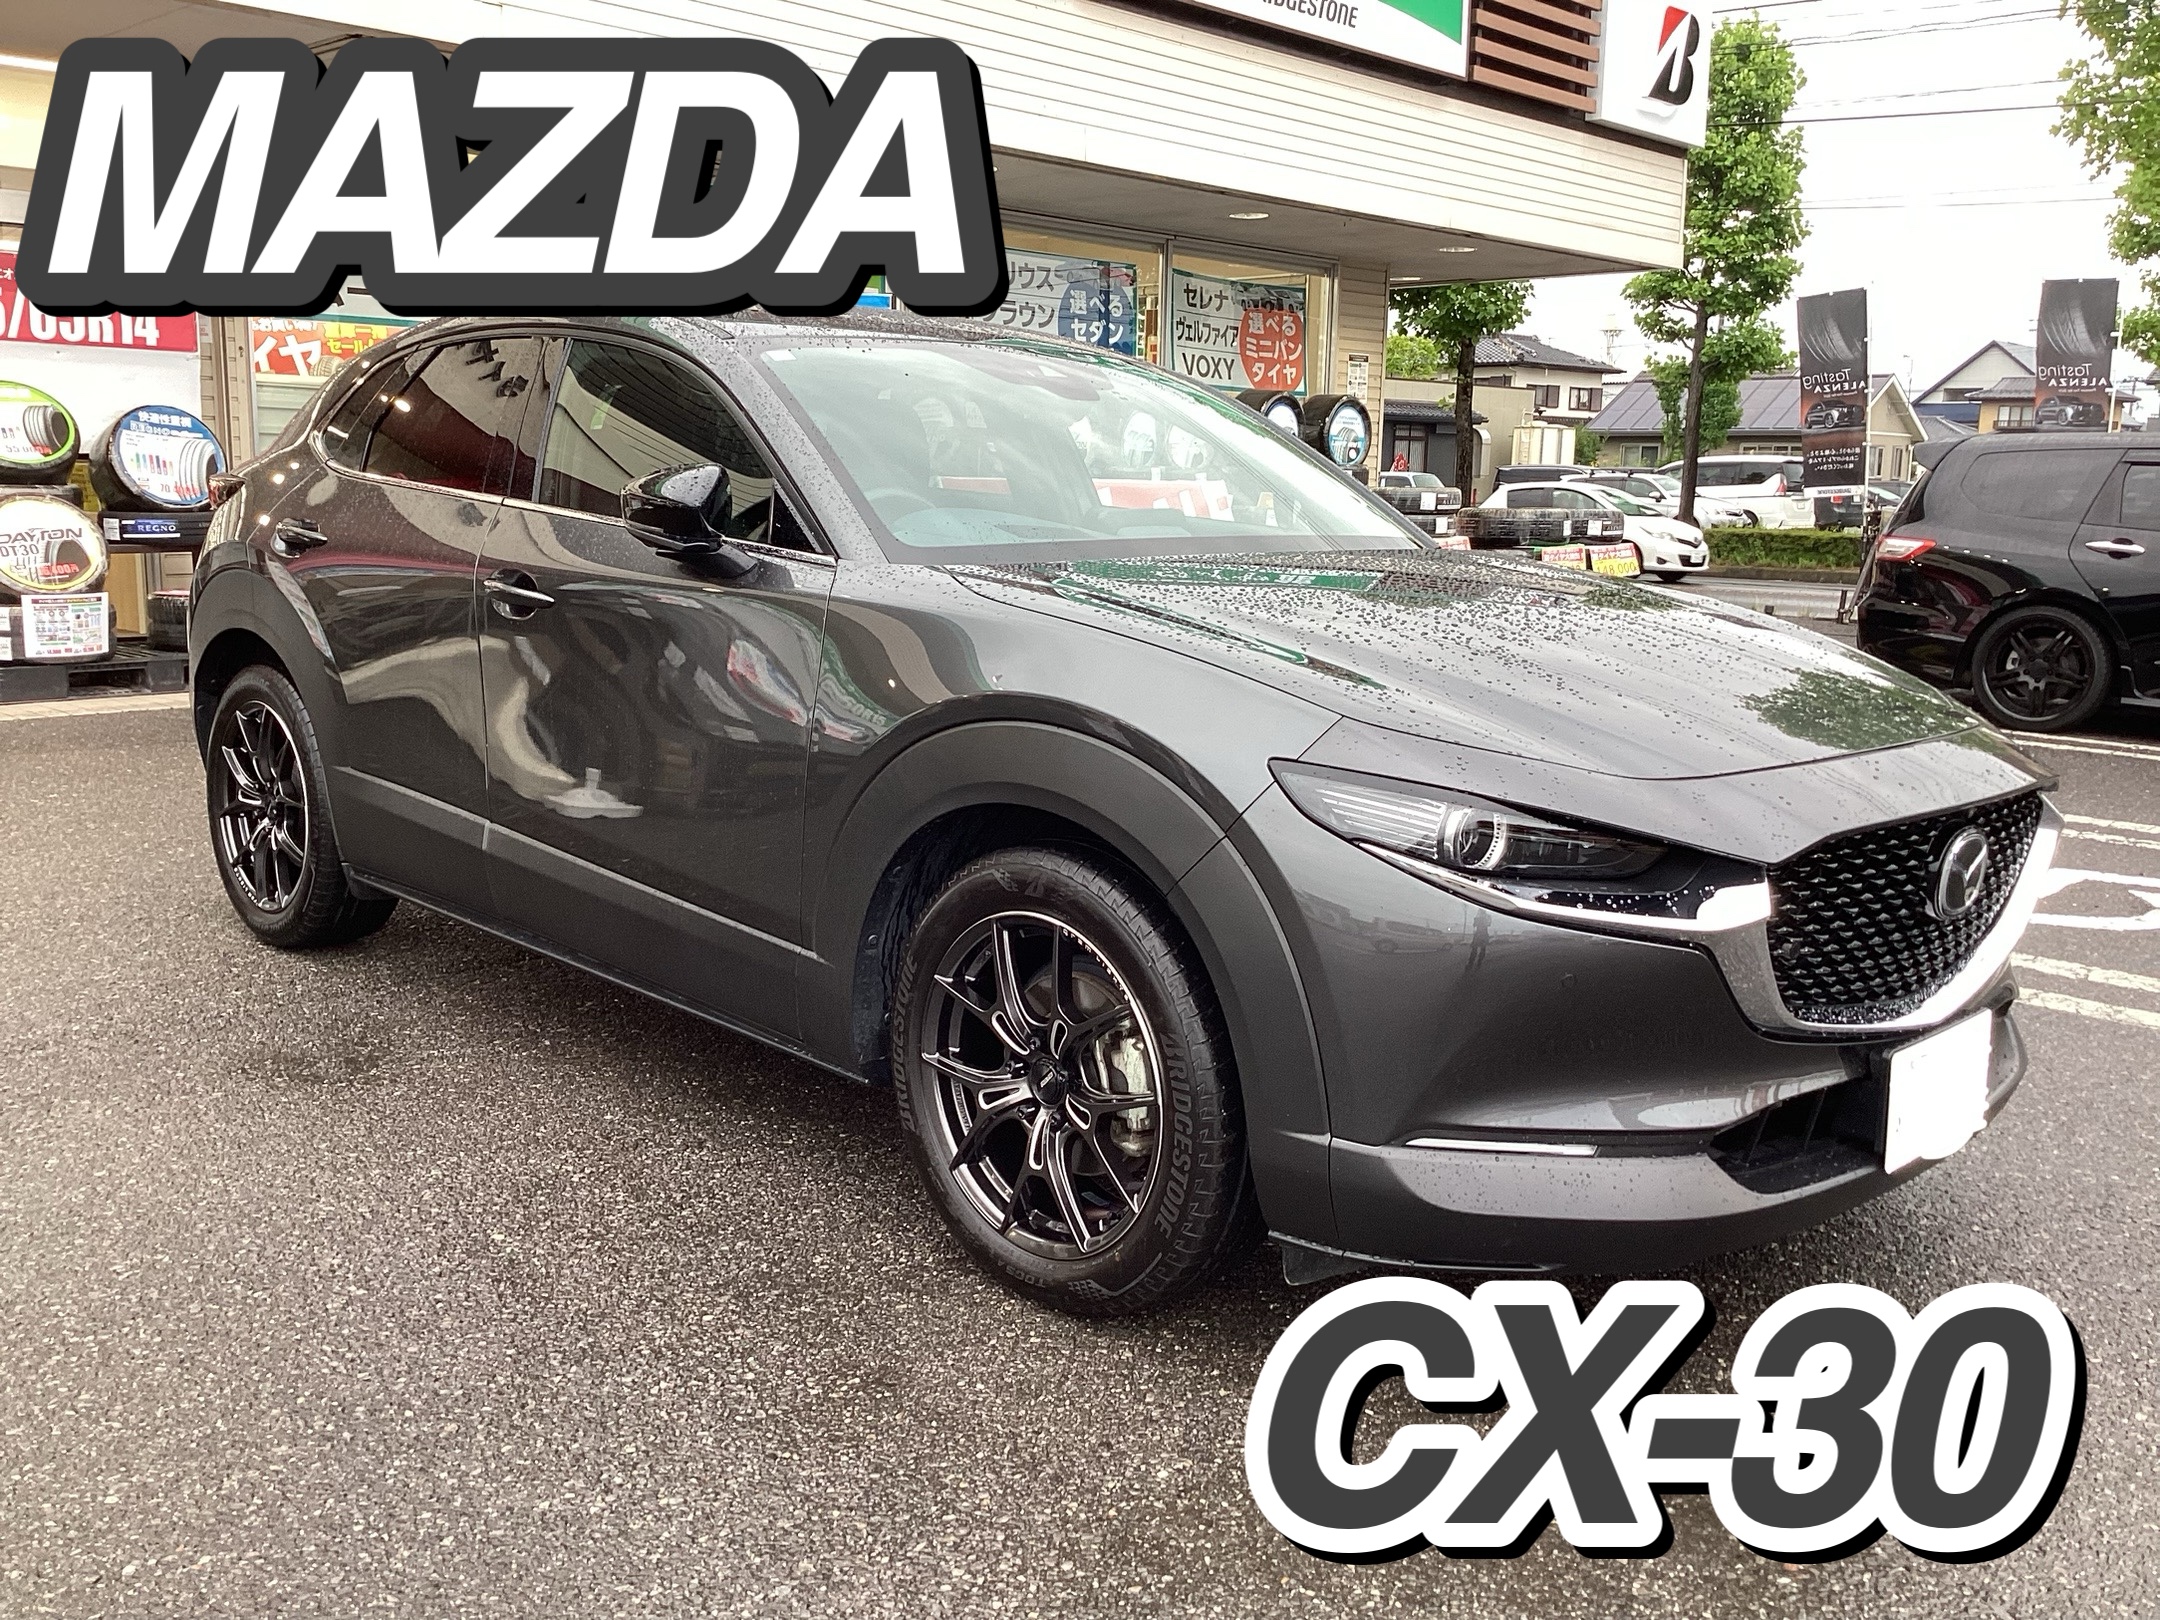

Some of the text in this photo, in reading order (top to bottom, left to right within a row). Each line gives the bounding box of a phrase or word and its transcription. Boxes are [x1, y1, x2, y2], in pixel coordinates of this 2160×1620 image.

[1069, 289, 1123, 318] 選べる
[1183, 282, 1229, 312] セレナ
[1070, 318, 1124, 345] セダン
[1176, 316, 1239, 348] ヴェルファイア
[1248, 311, 1296, 336] 選べる
[1245, 337, 1303, 361] ミニバン
[1182, 352, 1235, 381] VOXY
[1251, 362, 1297, 385] タイヤ
[0, 528, 83, 544] DAYTON
[137, 524, 177, 532] REGNO
[1154, 1031, 1195, 1239] BRIDGESTONE
